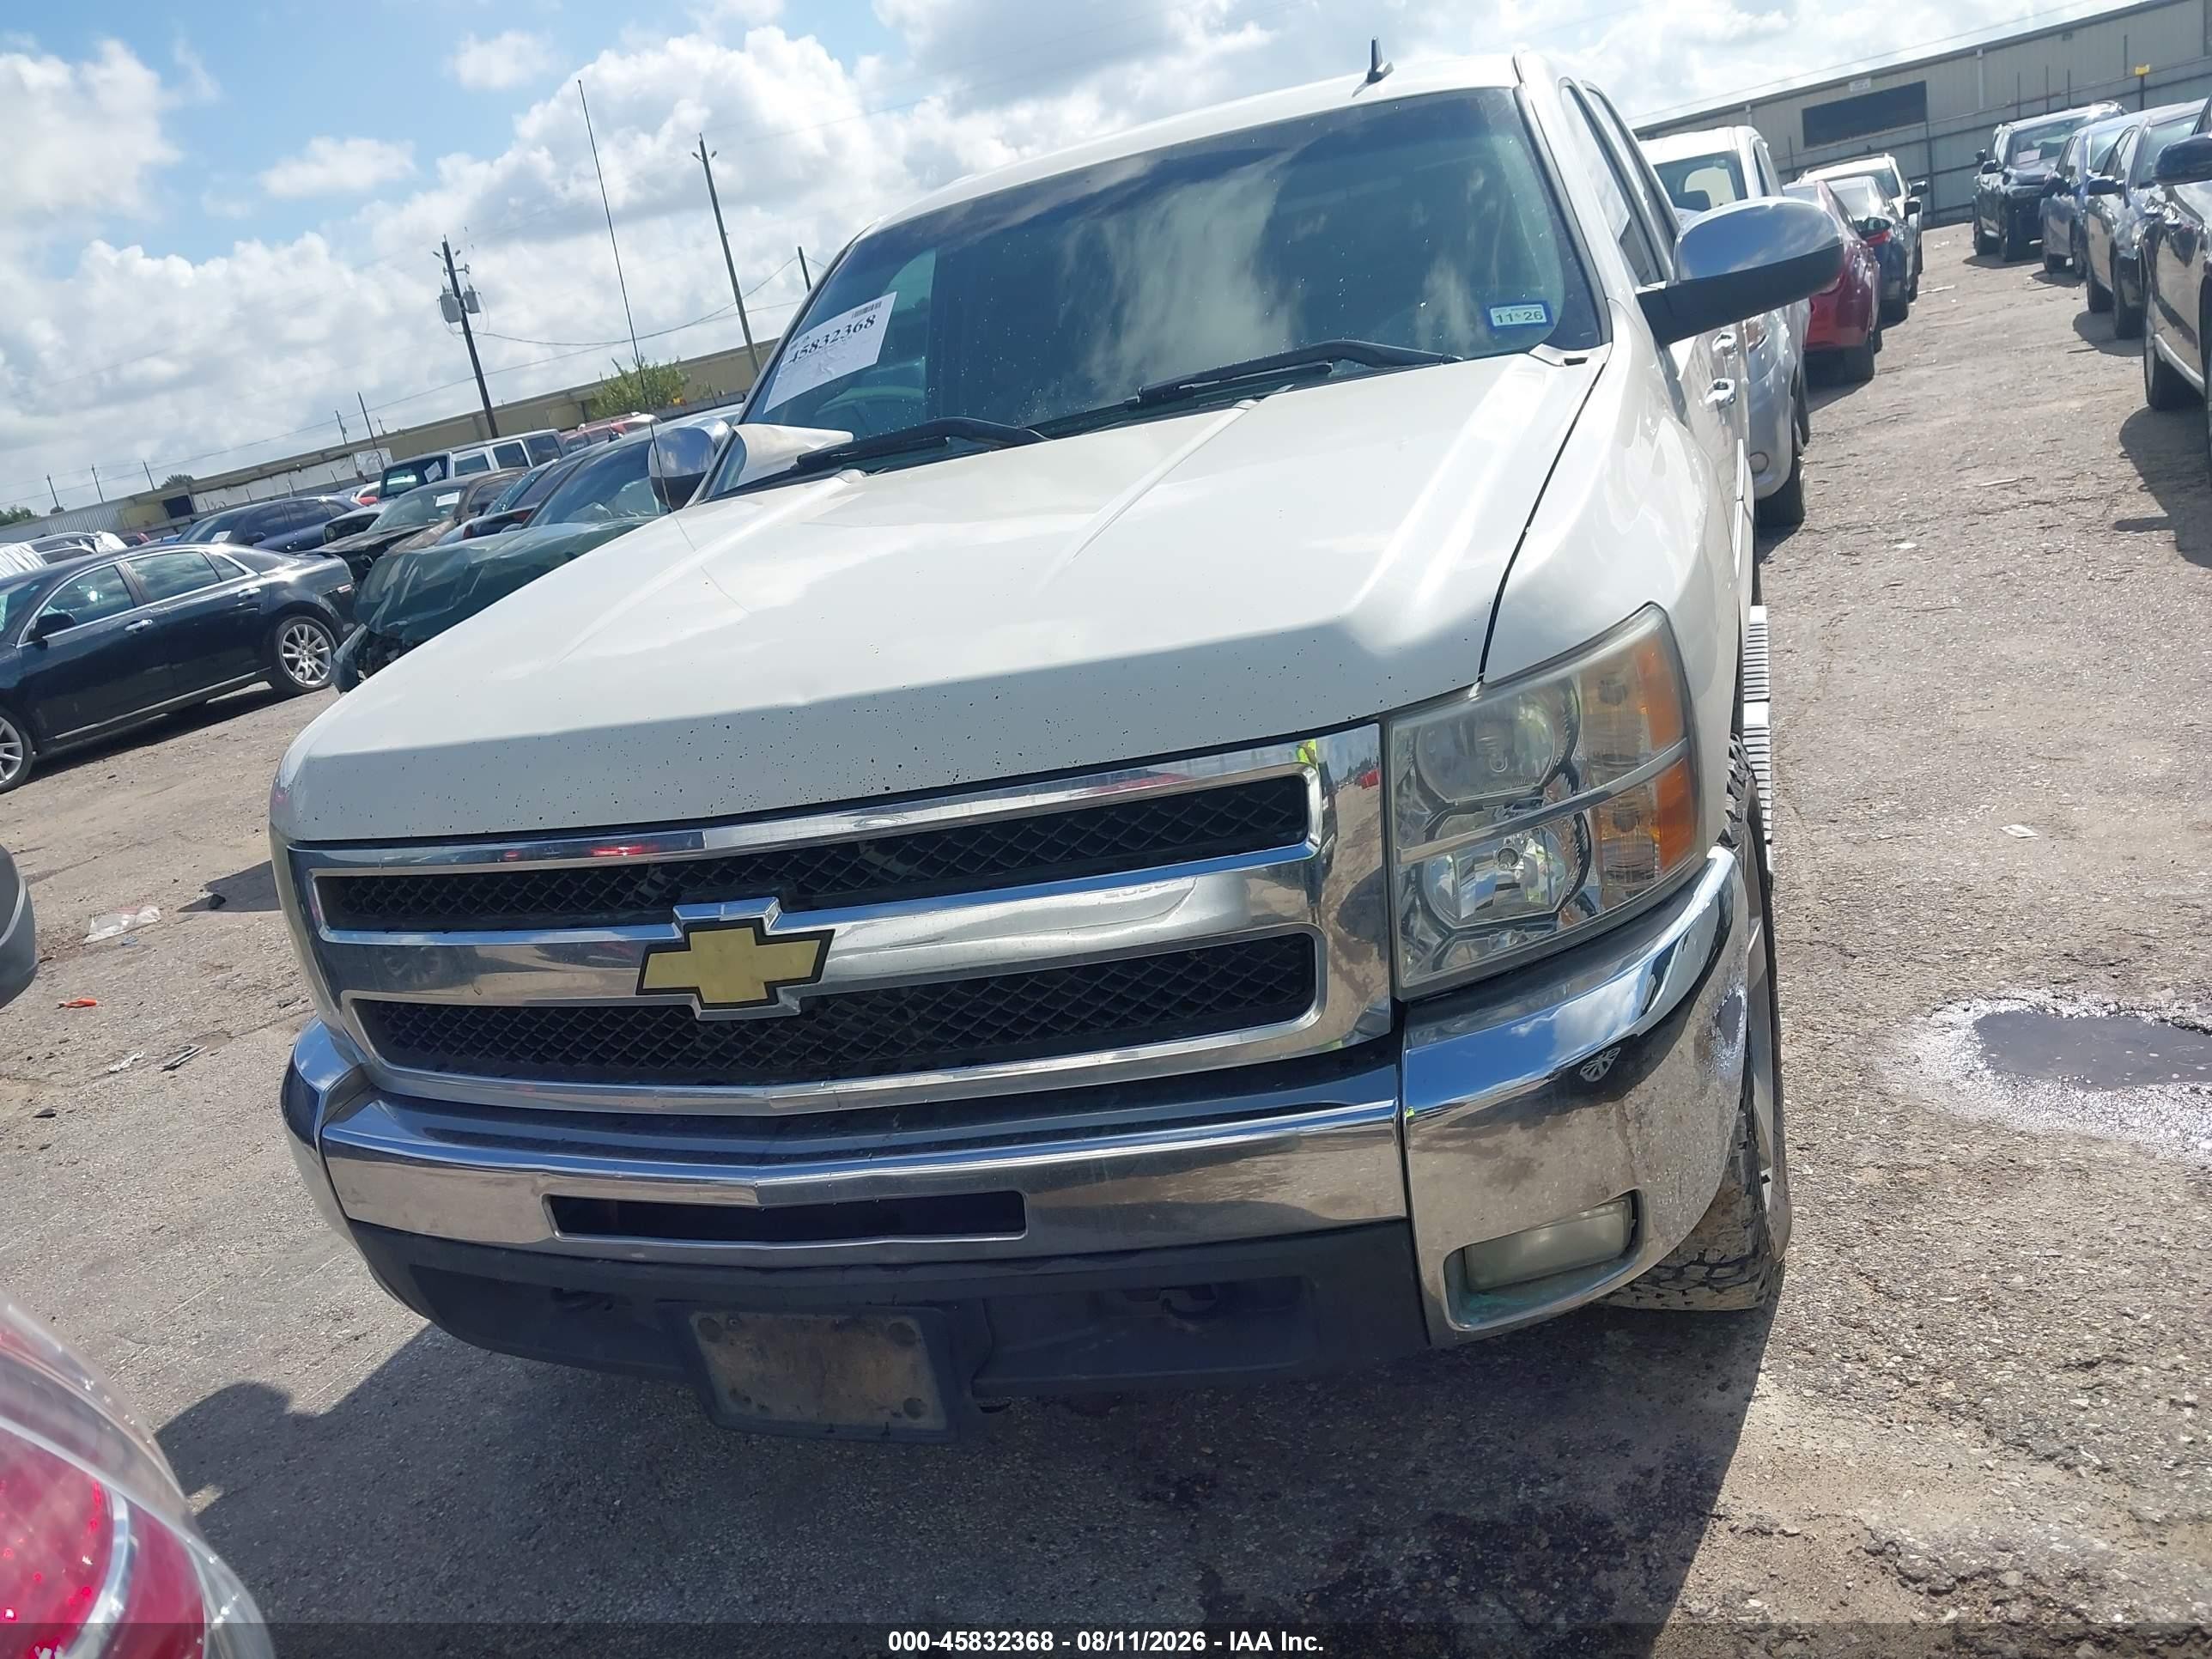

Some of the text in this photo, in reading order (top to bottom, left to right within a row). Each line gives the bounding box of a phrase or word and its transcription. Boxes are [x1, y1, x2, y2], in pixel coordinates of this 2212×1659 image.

[1496, 311, 1543, 324] 11 26
[788, 314, 877, 363] 45832368
